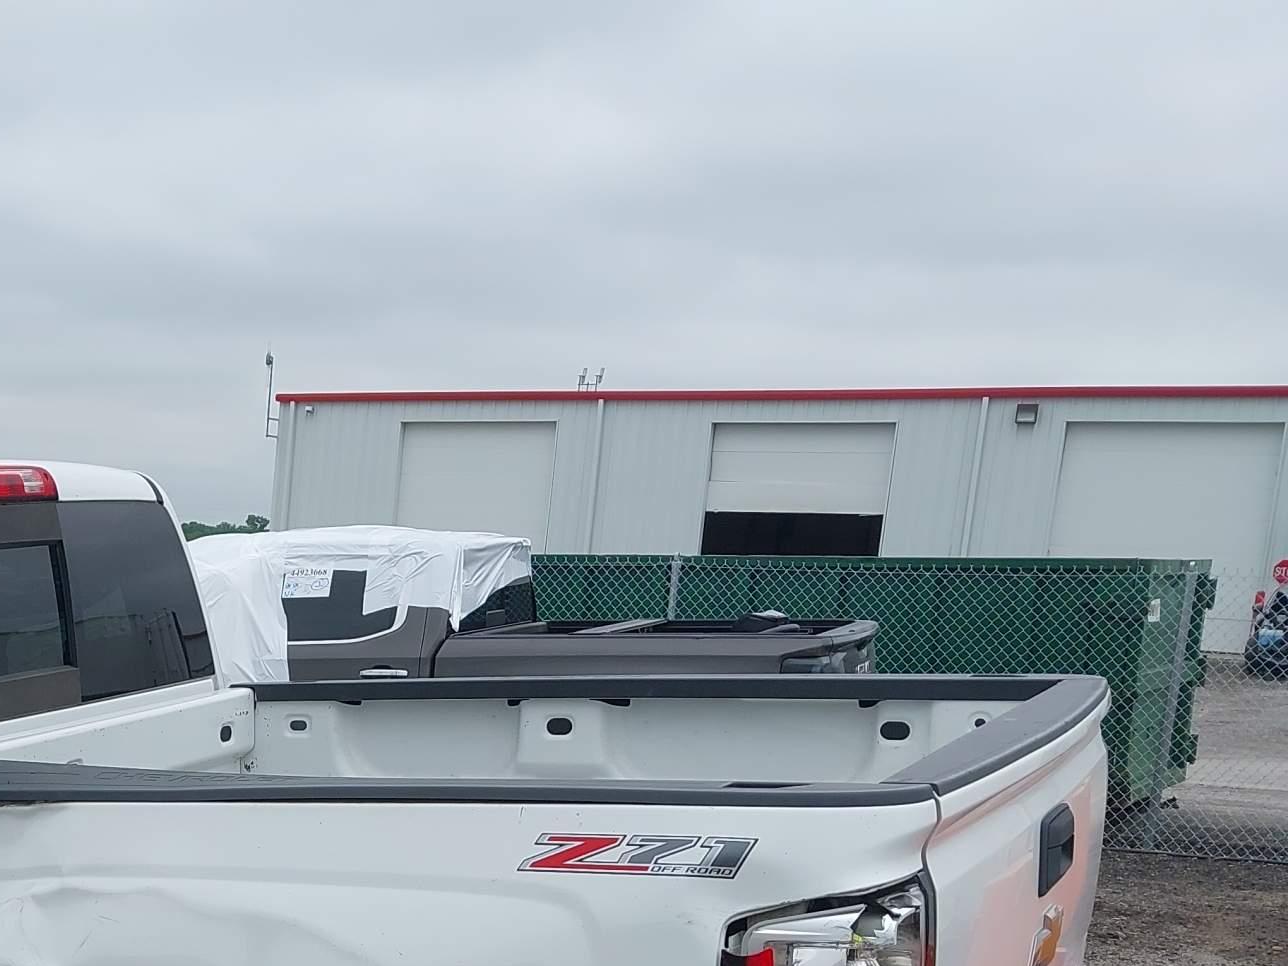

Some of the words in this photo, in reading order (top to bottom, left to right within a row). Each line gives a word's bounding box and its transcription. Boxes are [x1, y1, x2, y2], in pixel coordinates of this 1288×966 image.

[1275, 566, 1288, 577] ST
[517, 833, 759, 879] Z71
[650, 865, 683, 873] OFF
[685, 866, 734, 876] ROAD
